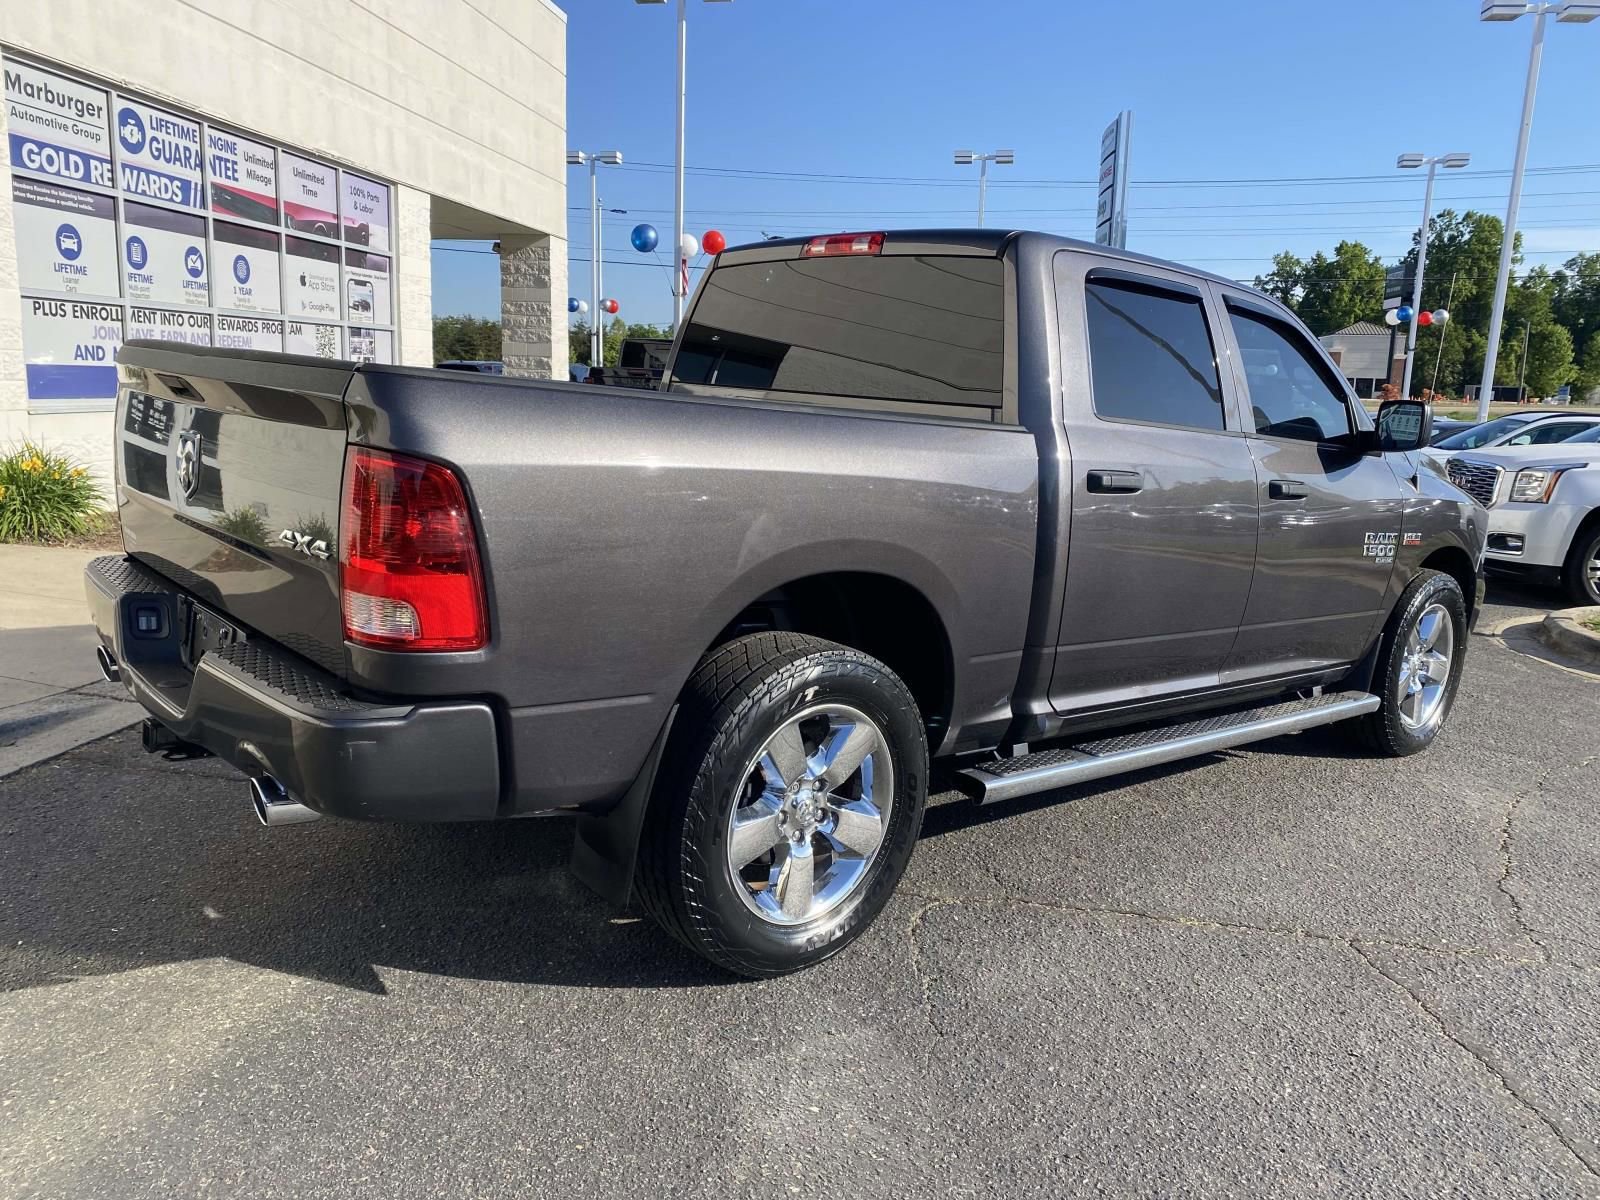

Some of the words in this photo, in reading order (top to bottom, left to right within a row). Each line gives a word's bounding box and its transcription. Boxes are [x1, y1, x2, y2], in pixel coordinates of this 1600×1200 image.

[4, 69, 103, 120] Marburger
[10, 105, 69, 133] Automotive
[72, 121, 101, 144] Group
[150, 114, 198, 145] LIFETIME
[208, 134, 238, 156] NGINE
[22, 142, 85, 180] GOLD
[244, 150, 275, 170] Unlimited
[246, 167, 272, 187] Mileage
[292, 166, 325, 186] Unlimited
[302, 184, 318, 198] Time
[350, 185, 366, 199] 100%
[367, 190, 380, 203] Parts
[359, 202, 374, 214] Labor
[54, 261, 88, 276] LIFETIME
[182, 279, 208, 291] LIFETIME
[239, 287, 253, 297] YEAR
[308, 280, 320, 291] App
[33, 300, 67, 318] PLUS
[160, 312, 185, 328] INTO
[187, 314, 209, 329] OUR
[74, 344, 105, 361] AND
[1364, 532, 1398, 544] RAM
[1363, 544, 1395, 557] 1500
